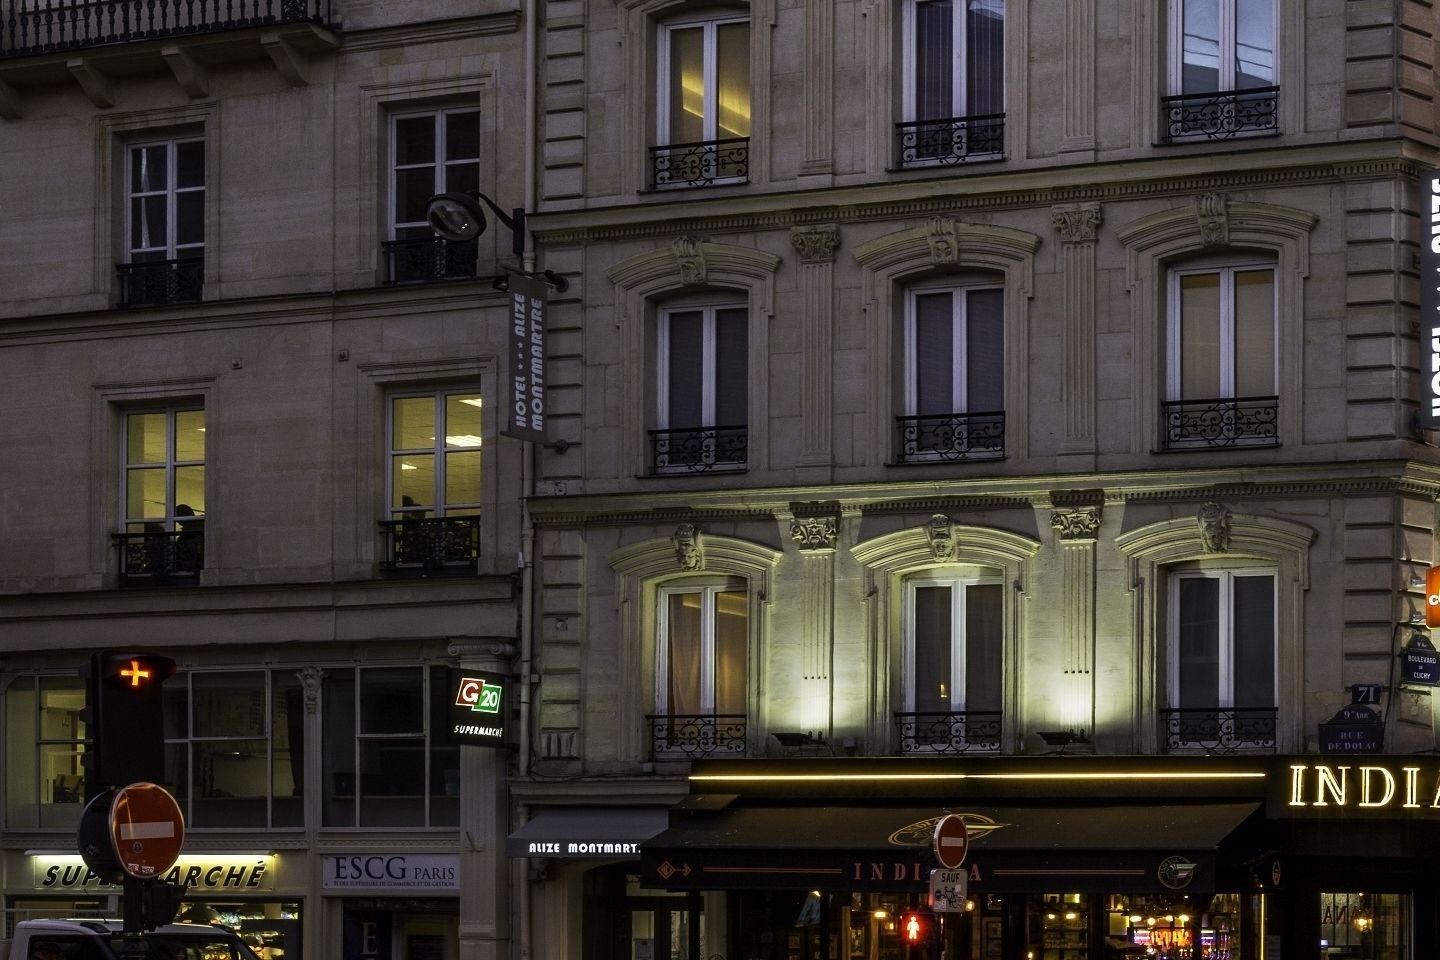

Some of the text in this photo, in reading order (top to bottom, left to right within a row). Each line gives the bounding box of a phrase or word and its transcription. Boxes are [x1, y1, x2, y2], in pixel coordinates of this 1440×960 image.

[514, 292, 527, 428] HOTEL ALIZE
[530, 297, 543, 432] MONTMARTRE
[1407, 655, 1437, 665] BOULEVARD
[1413, 672, 1431, 680] CLICHY
[1358, 686, 1376, 702] 71
[1340, 731, 1364, 740] RUE
[529, 843, 641, 854] ALIZE MONTMART
[42, 860, 265, 888] SUPARCHÉ
[333, 856, 455, 880] ESCG PARIS
[854, 863, 982, 881] INDIA
[941, 873, 960, 883] SAUF
